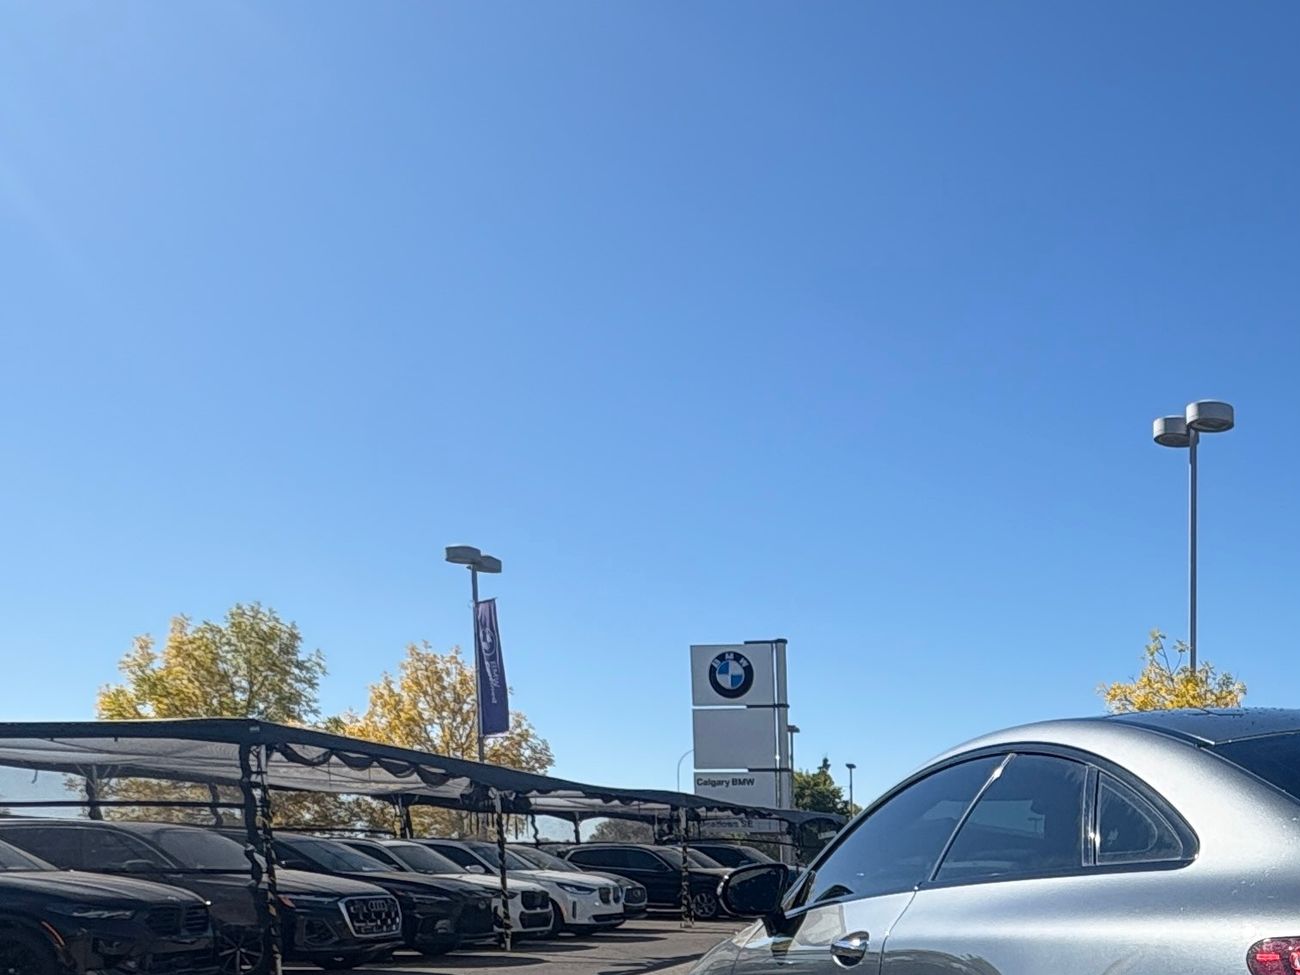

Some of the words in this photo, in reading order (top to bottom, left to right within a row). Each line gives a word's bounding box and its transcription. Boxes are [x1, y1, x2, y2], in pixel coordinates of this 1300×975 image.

[711, 652, 749, 668] BMW
[696, 777, 729, 788] Calgary
[731, 777, 755, 786] BMW
